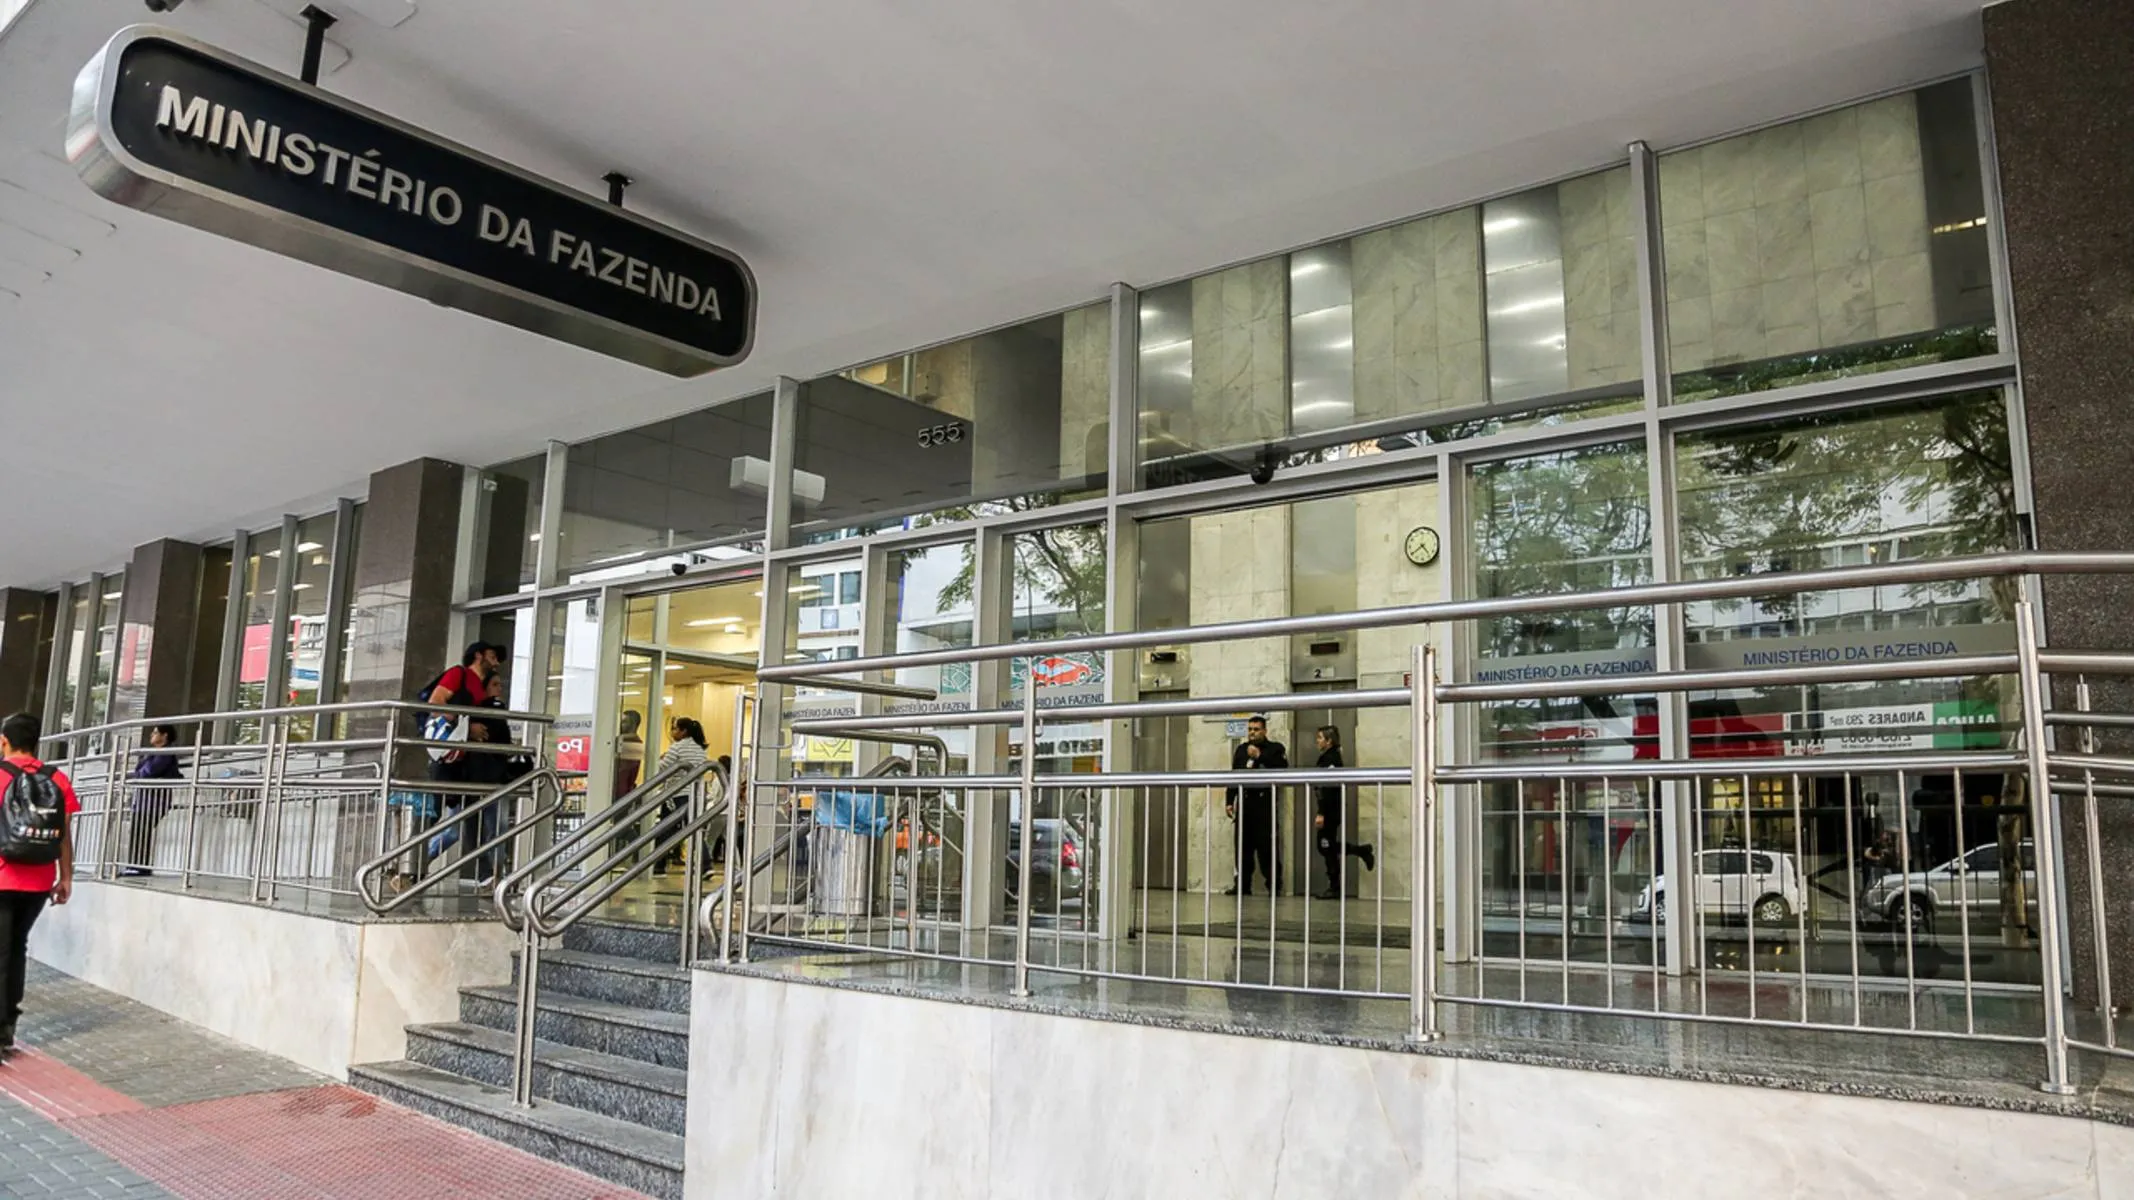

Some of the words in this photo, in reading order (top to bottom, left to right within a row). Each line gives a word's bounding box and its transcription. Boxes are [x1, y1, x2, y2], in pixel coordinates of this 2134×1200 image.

[156, 84, 463, 225] MINISTÉRIO
[478, 203, 536, 257] DA
[550, 229, 722, 322] FAZENDA
[918, 421, 962, 448] 555
[1744, 645, 1840, 665] MINISTÉRIO
[1845, 646, 1869, 660] DA
[1873, 640, 1958, 657] FAZENDA
[1314, 669, 1322, 679] 2
[1478, 664, 1557, 682] MINISTÉRIO
[1561, 665, 1582, 677] DA
[1584, 660, 1653, 675] FAZENDA
